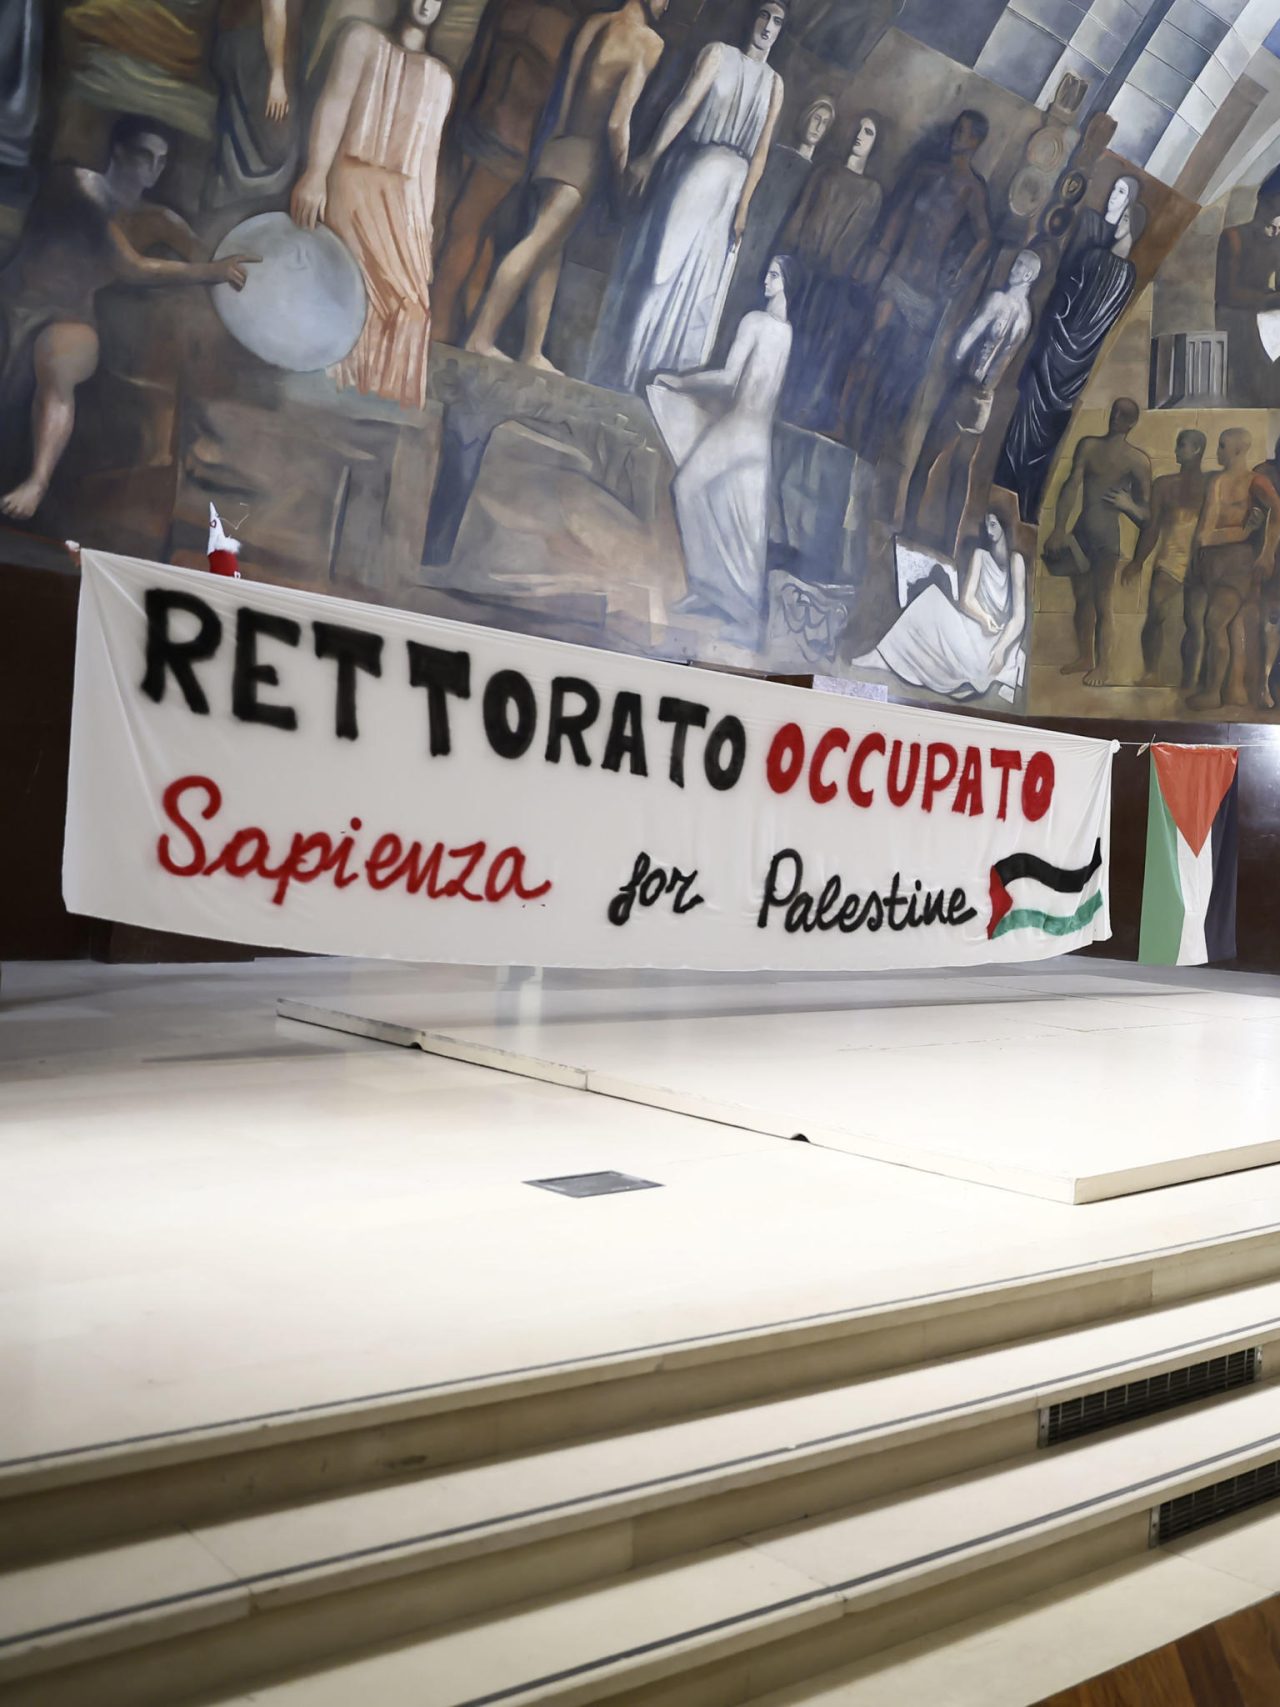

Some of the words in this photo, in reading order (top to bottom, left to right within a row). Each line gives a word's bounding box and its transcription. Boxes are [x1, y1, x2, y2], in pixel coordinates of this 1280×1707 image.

[139, 587, 748, 791] RETTORATO
[765, 721, 1056, 823] OCCUPATO
[157, 775, 552, 906] Sapienza
[606, 851, 706, 928] for
[756, 847, 979, 934] Palestine
